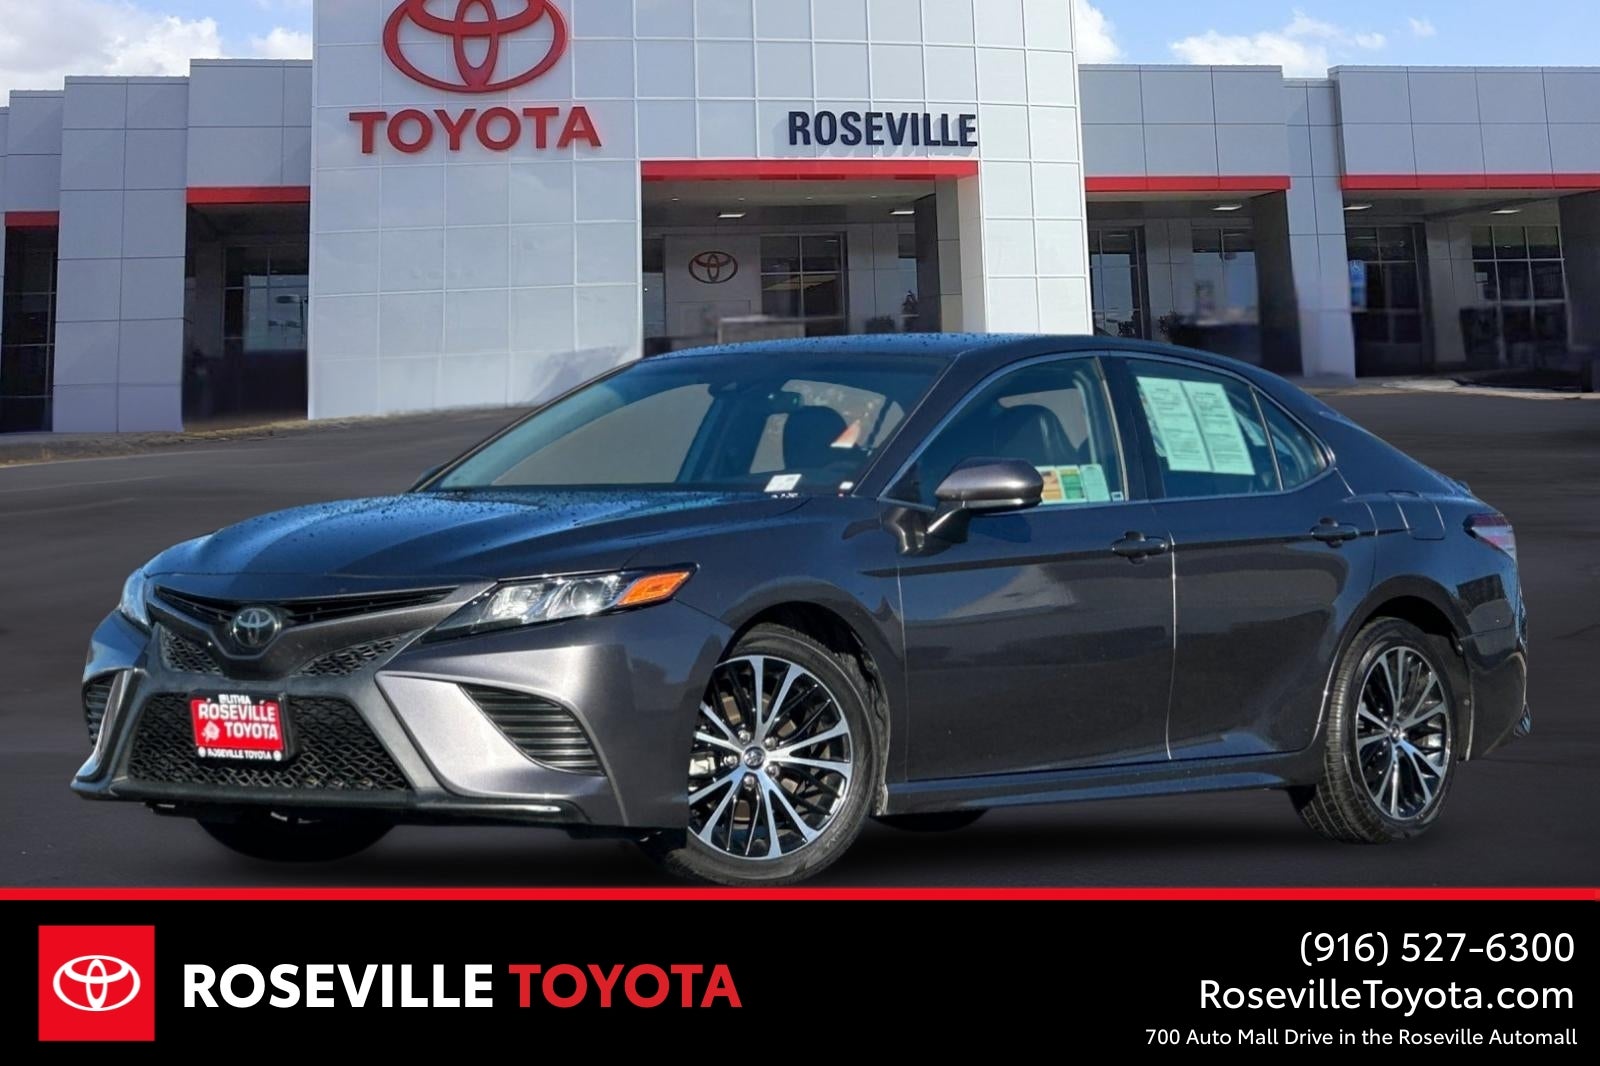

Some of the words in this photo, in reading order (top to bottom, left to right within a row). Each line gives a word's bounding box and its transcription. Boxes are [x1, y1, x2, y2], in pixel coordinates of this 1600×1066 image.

[350, 106, 602, 154] TOYOTA
[788, 110, 978, 147] ROSEVILLE
[198, 703, 275, 722] ROSEVILLE
[224, 721, 278, 741] TOYOTA
[207, 748, 244, 759] ROSEVILLE
[244, 750, 272, 760] TOYOTA
